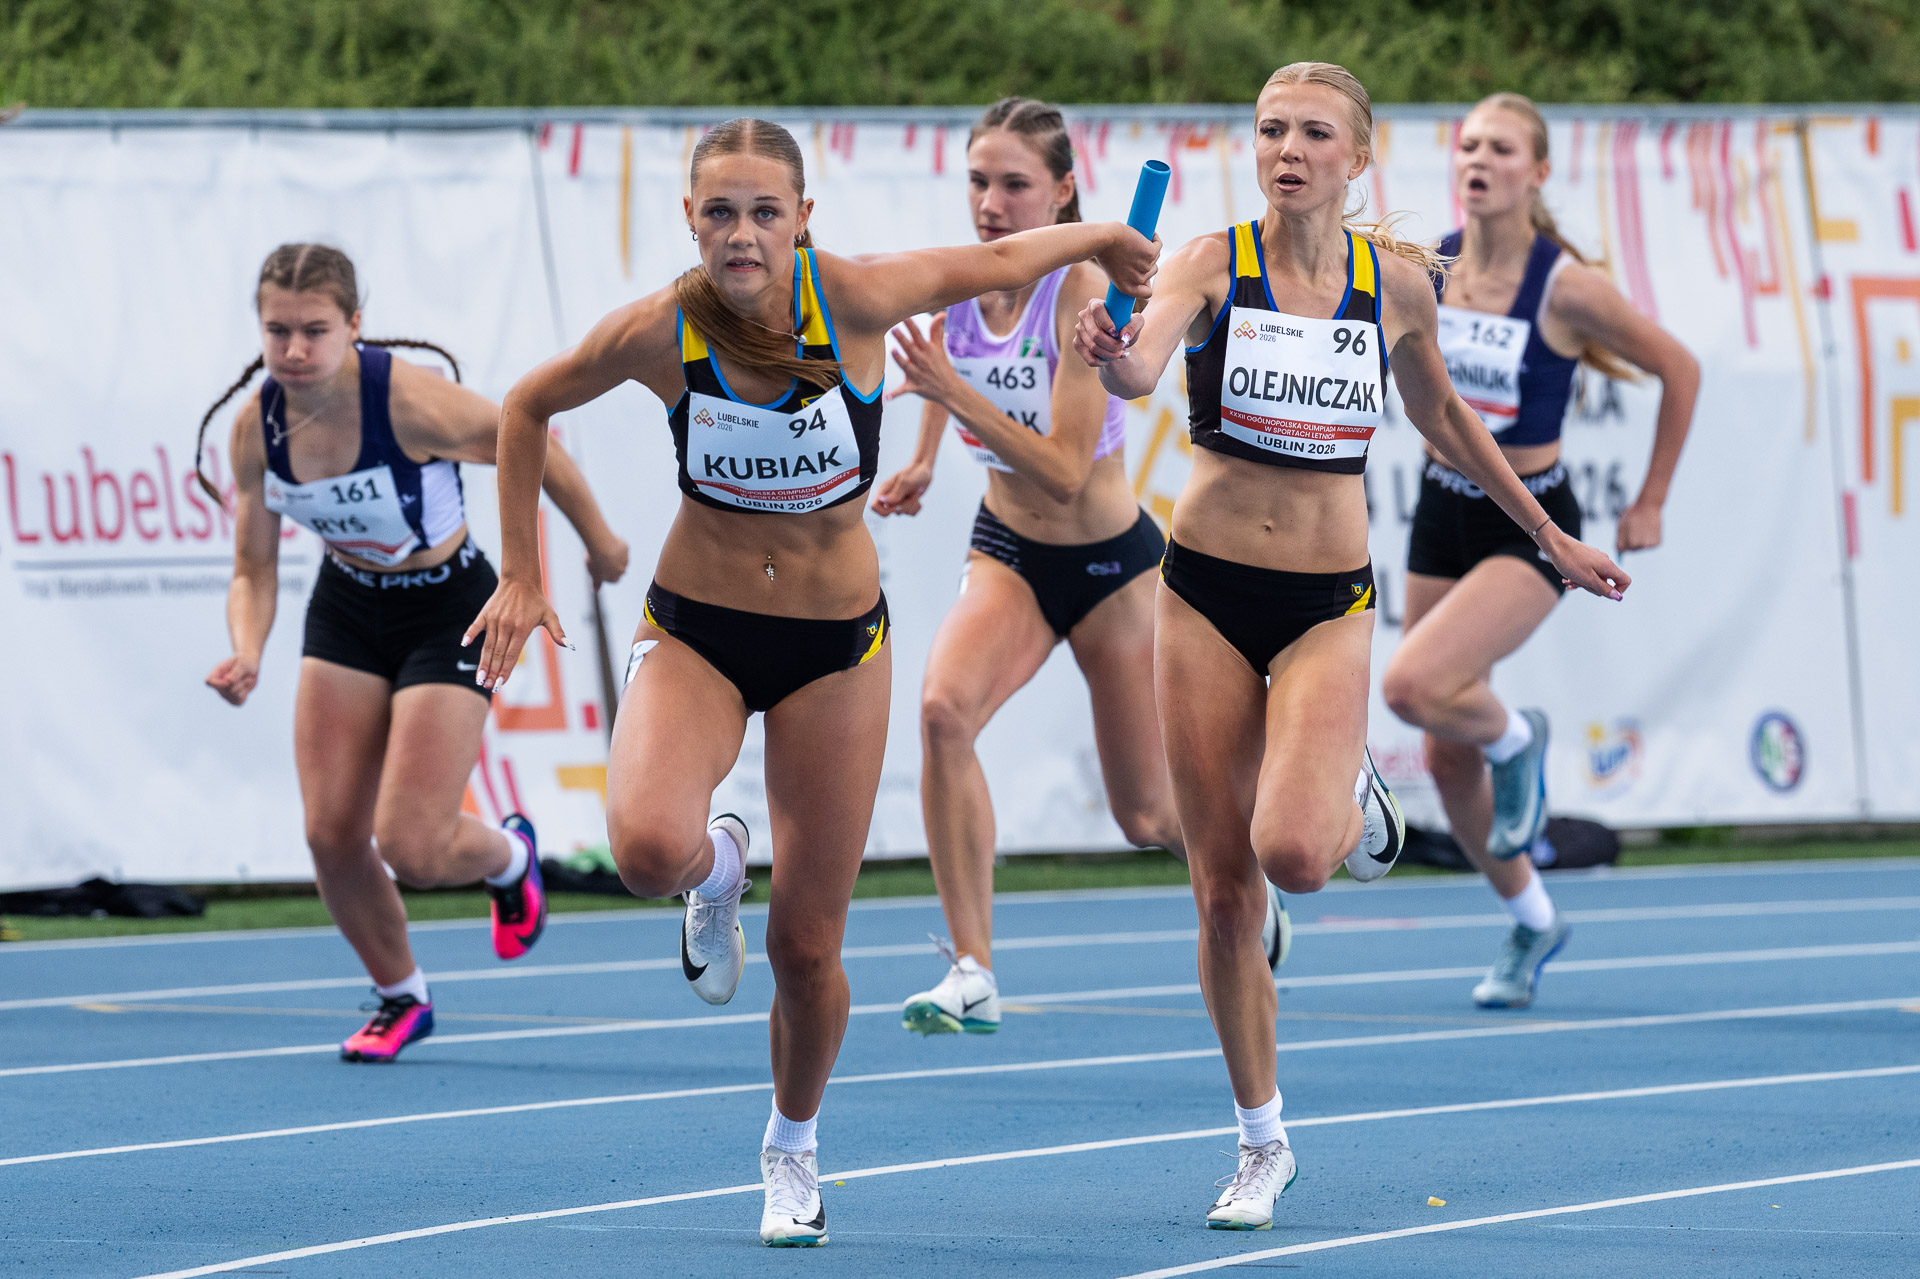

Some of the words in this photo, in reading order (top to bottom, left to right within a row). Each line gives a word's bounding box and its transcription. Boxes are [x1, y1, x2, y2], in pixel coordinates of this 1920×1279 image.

[1259, 333, 1277, 343] 2026
[1260, 323, 1304, 338] LUBELSKIE
[1333, 327, 1367, 356] 96
[1471, 321, 1514, 349] 162
[986, 366, 1036, 389] 463
[1229, 366, 1377, 413] OLEJNICZAK
[717, 411, 760, 429] LUBELSKIE
[717, 422, 733, 432] 2026
[788, 407, 827, 439] 94
[1229, 409, 1246, 420] XXXII
[1246, 415, 1302, 430] OGÓLNOPOLSKA
[1303, 423, 1336, 433] OLIMPIADA
[1257, 434, 1305, 453] LUBLIN
[1307, 443, 1336, 455] 2026
[1273, 427, 1311, 438] SPORTACH
[1311, 432, 1335, 440] LETNICH
[703, 445, 842, 480] KUBIAK
[330, 478, 382, 504] 161
[777, 487, 816, 496] OLIMPIADA
[788, 491, 817, 500] LETNICH
[735, 497, 784, 510] LUBLIN
[788, 497, 823, 510] 2026
[380, 564, 451, 590] PRO
